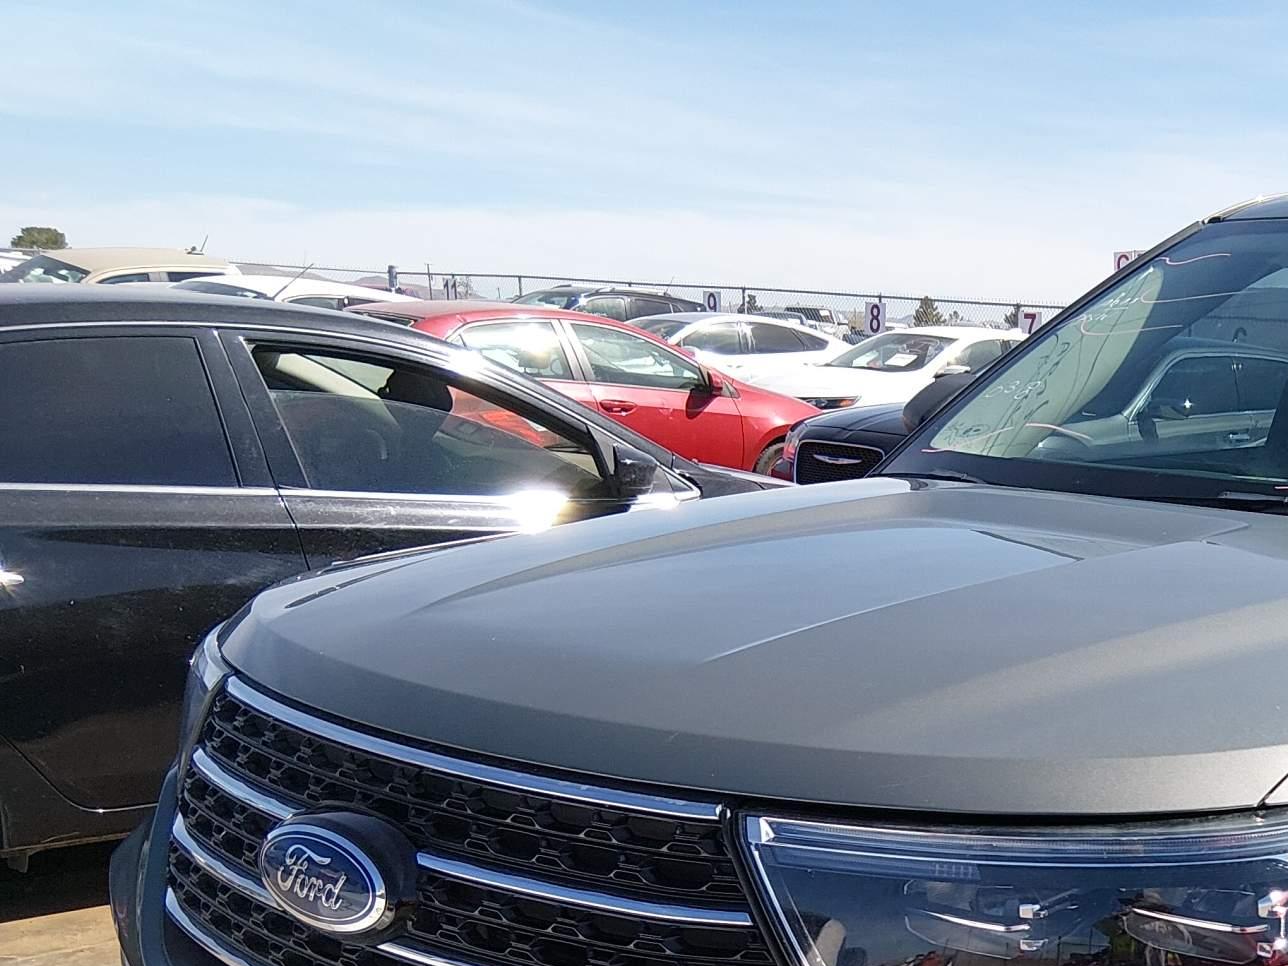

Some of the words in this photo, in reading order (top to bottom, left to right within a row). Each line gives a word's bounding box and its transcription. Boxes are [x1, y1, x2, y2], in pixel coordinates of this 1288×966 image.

[707, 292, 717, 312] 9
[870, 304, 880, 333] 8
[1023, 312, 1036, 334] 7
[277, 844, 348, 910] Ford
